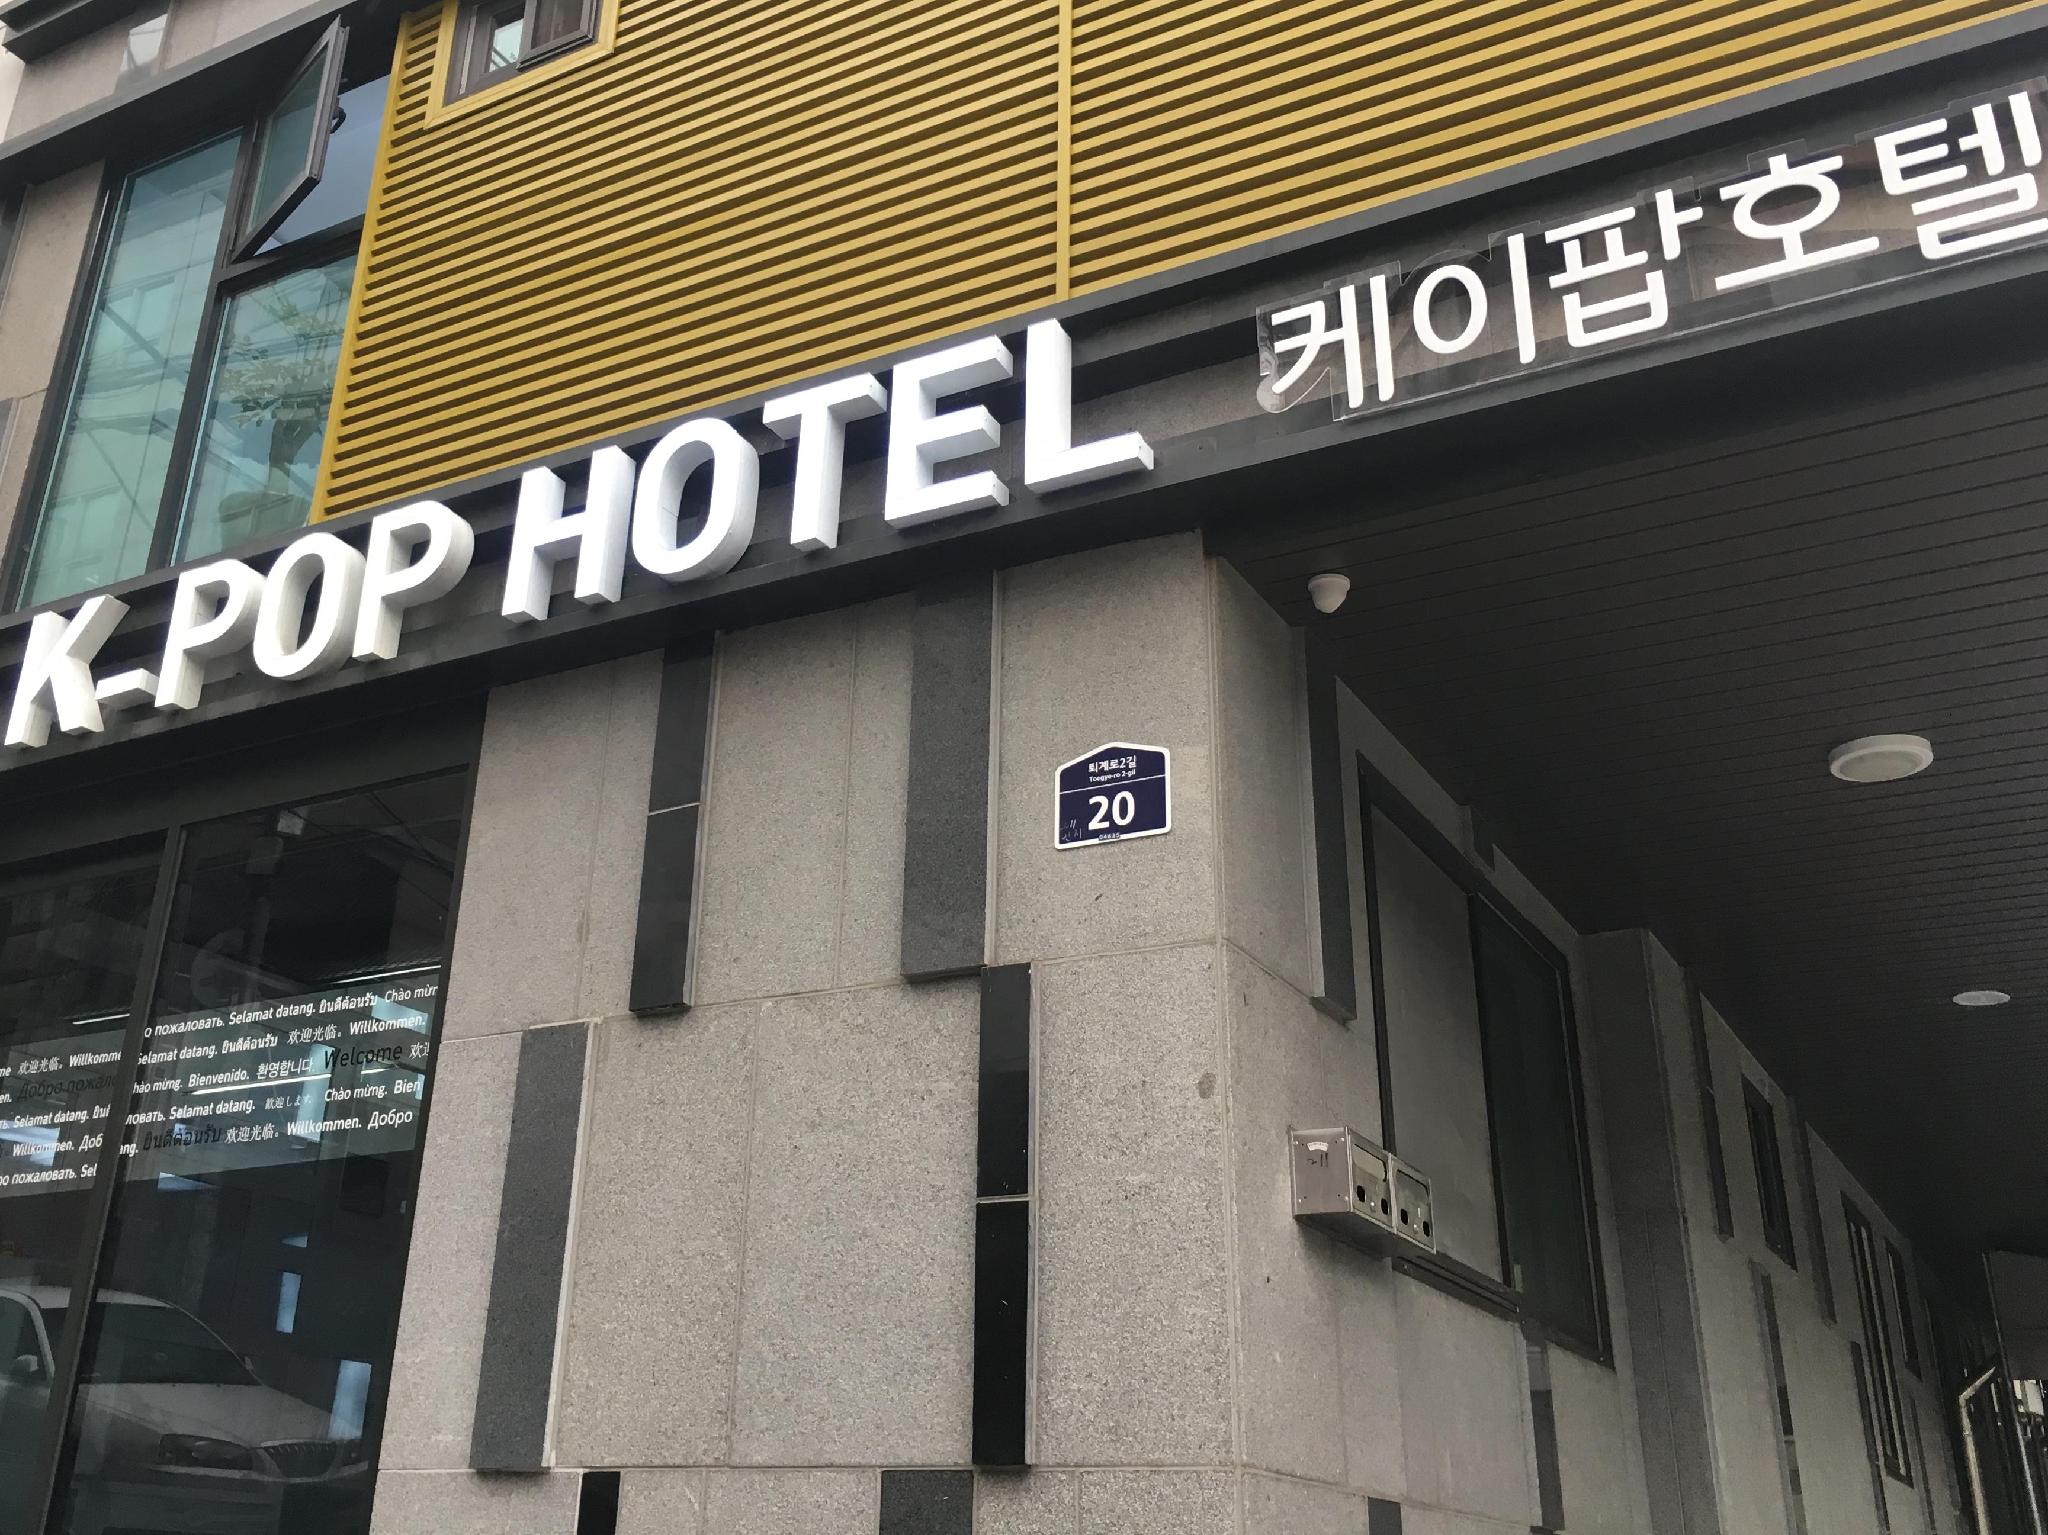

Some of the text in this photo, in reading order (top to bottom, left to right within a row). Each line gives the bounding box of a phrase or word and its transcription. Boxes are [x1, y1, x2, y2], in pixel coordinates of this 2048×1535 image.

[1271, 91, 2048, 409] 케이팝호텔
[4, 318, 1154, 746] K-POP HOTEL
[1088, 755, 1136, 773] 퇴계로2길
[1121, 768, 1136, 777] 2-gil
[1088, 790, 1135, 830] 20
[154, 1017, 225, 1036] пожаловать.
[228, 1007, 274, 1025] Selamat
[275, 1003, 316, 1017] datang.
[385, 987, 412, 1003] Chào
[179, 1045, 218, 1058] datang.
[350, 1015, 426, 1035] Willkommen.
[152, 1077, 183, 1092] mừng.
[188, 1067, 250, 1088] Bienvenido.
[256, 1056, 314, 1079] 환영합니다
[325, 1045, 402, 1070] Welcome
[13, 1111, 53, 1128] Selamat
[53, 1109, 90, 1124] datang.
[168, 1101, 214, 1119] Selamat
[215, 1099, 256, 1115] datang.
[324, 1086, 352, 1102] Chào
[353, 1083, 388, 1098] mừng.
[287, 1116, 362, 1136] Willkommen.
[367, 1108, 413, 1130] Добро
[12, 1140, 75, 1157] Willkommen.
[11, 1167, 77, 1185] пожаловать.
